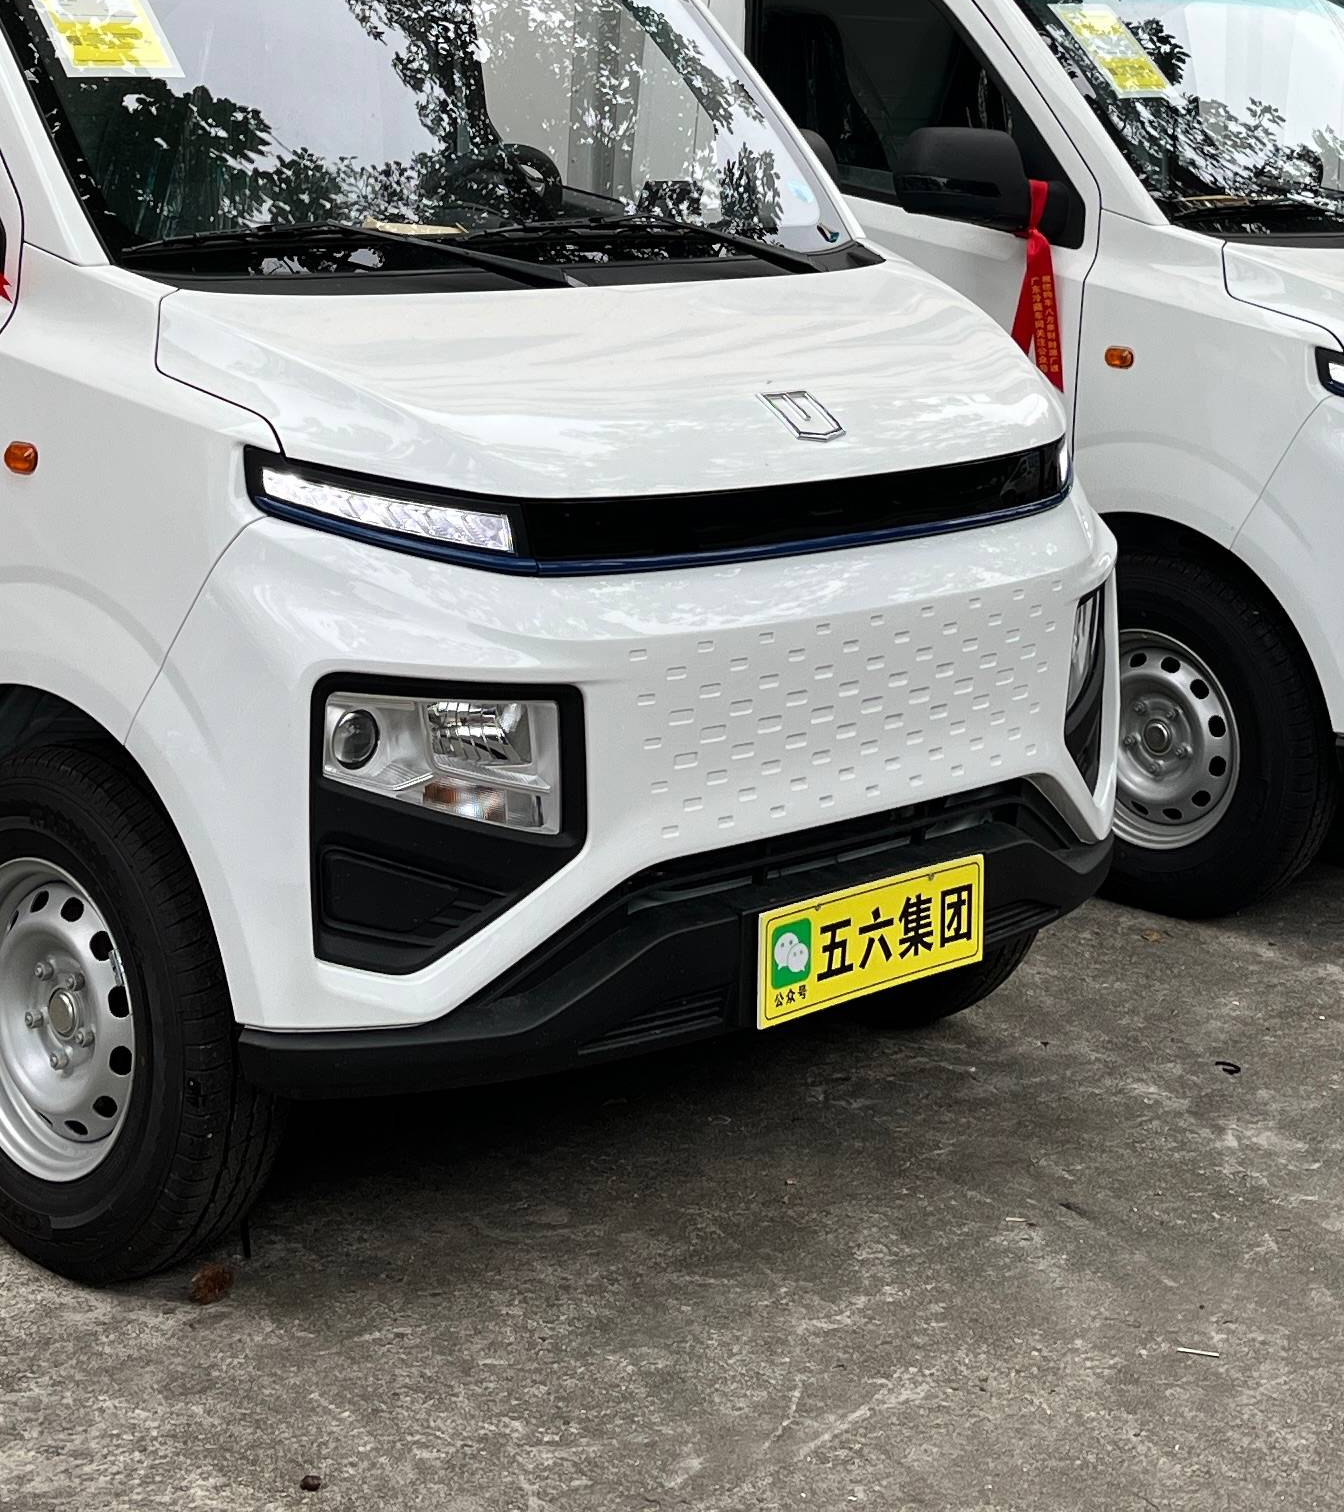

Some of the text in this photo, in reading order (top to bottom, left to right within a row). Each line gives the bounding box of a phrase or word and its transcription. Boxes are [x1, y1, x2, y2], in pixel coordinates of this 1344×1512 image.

[816, 883, 973, 983] 五六集团
[774, 984, 808, 1008] 公众号
